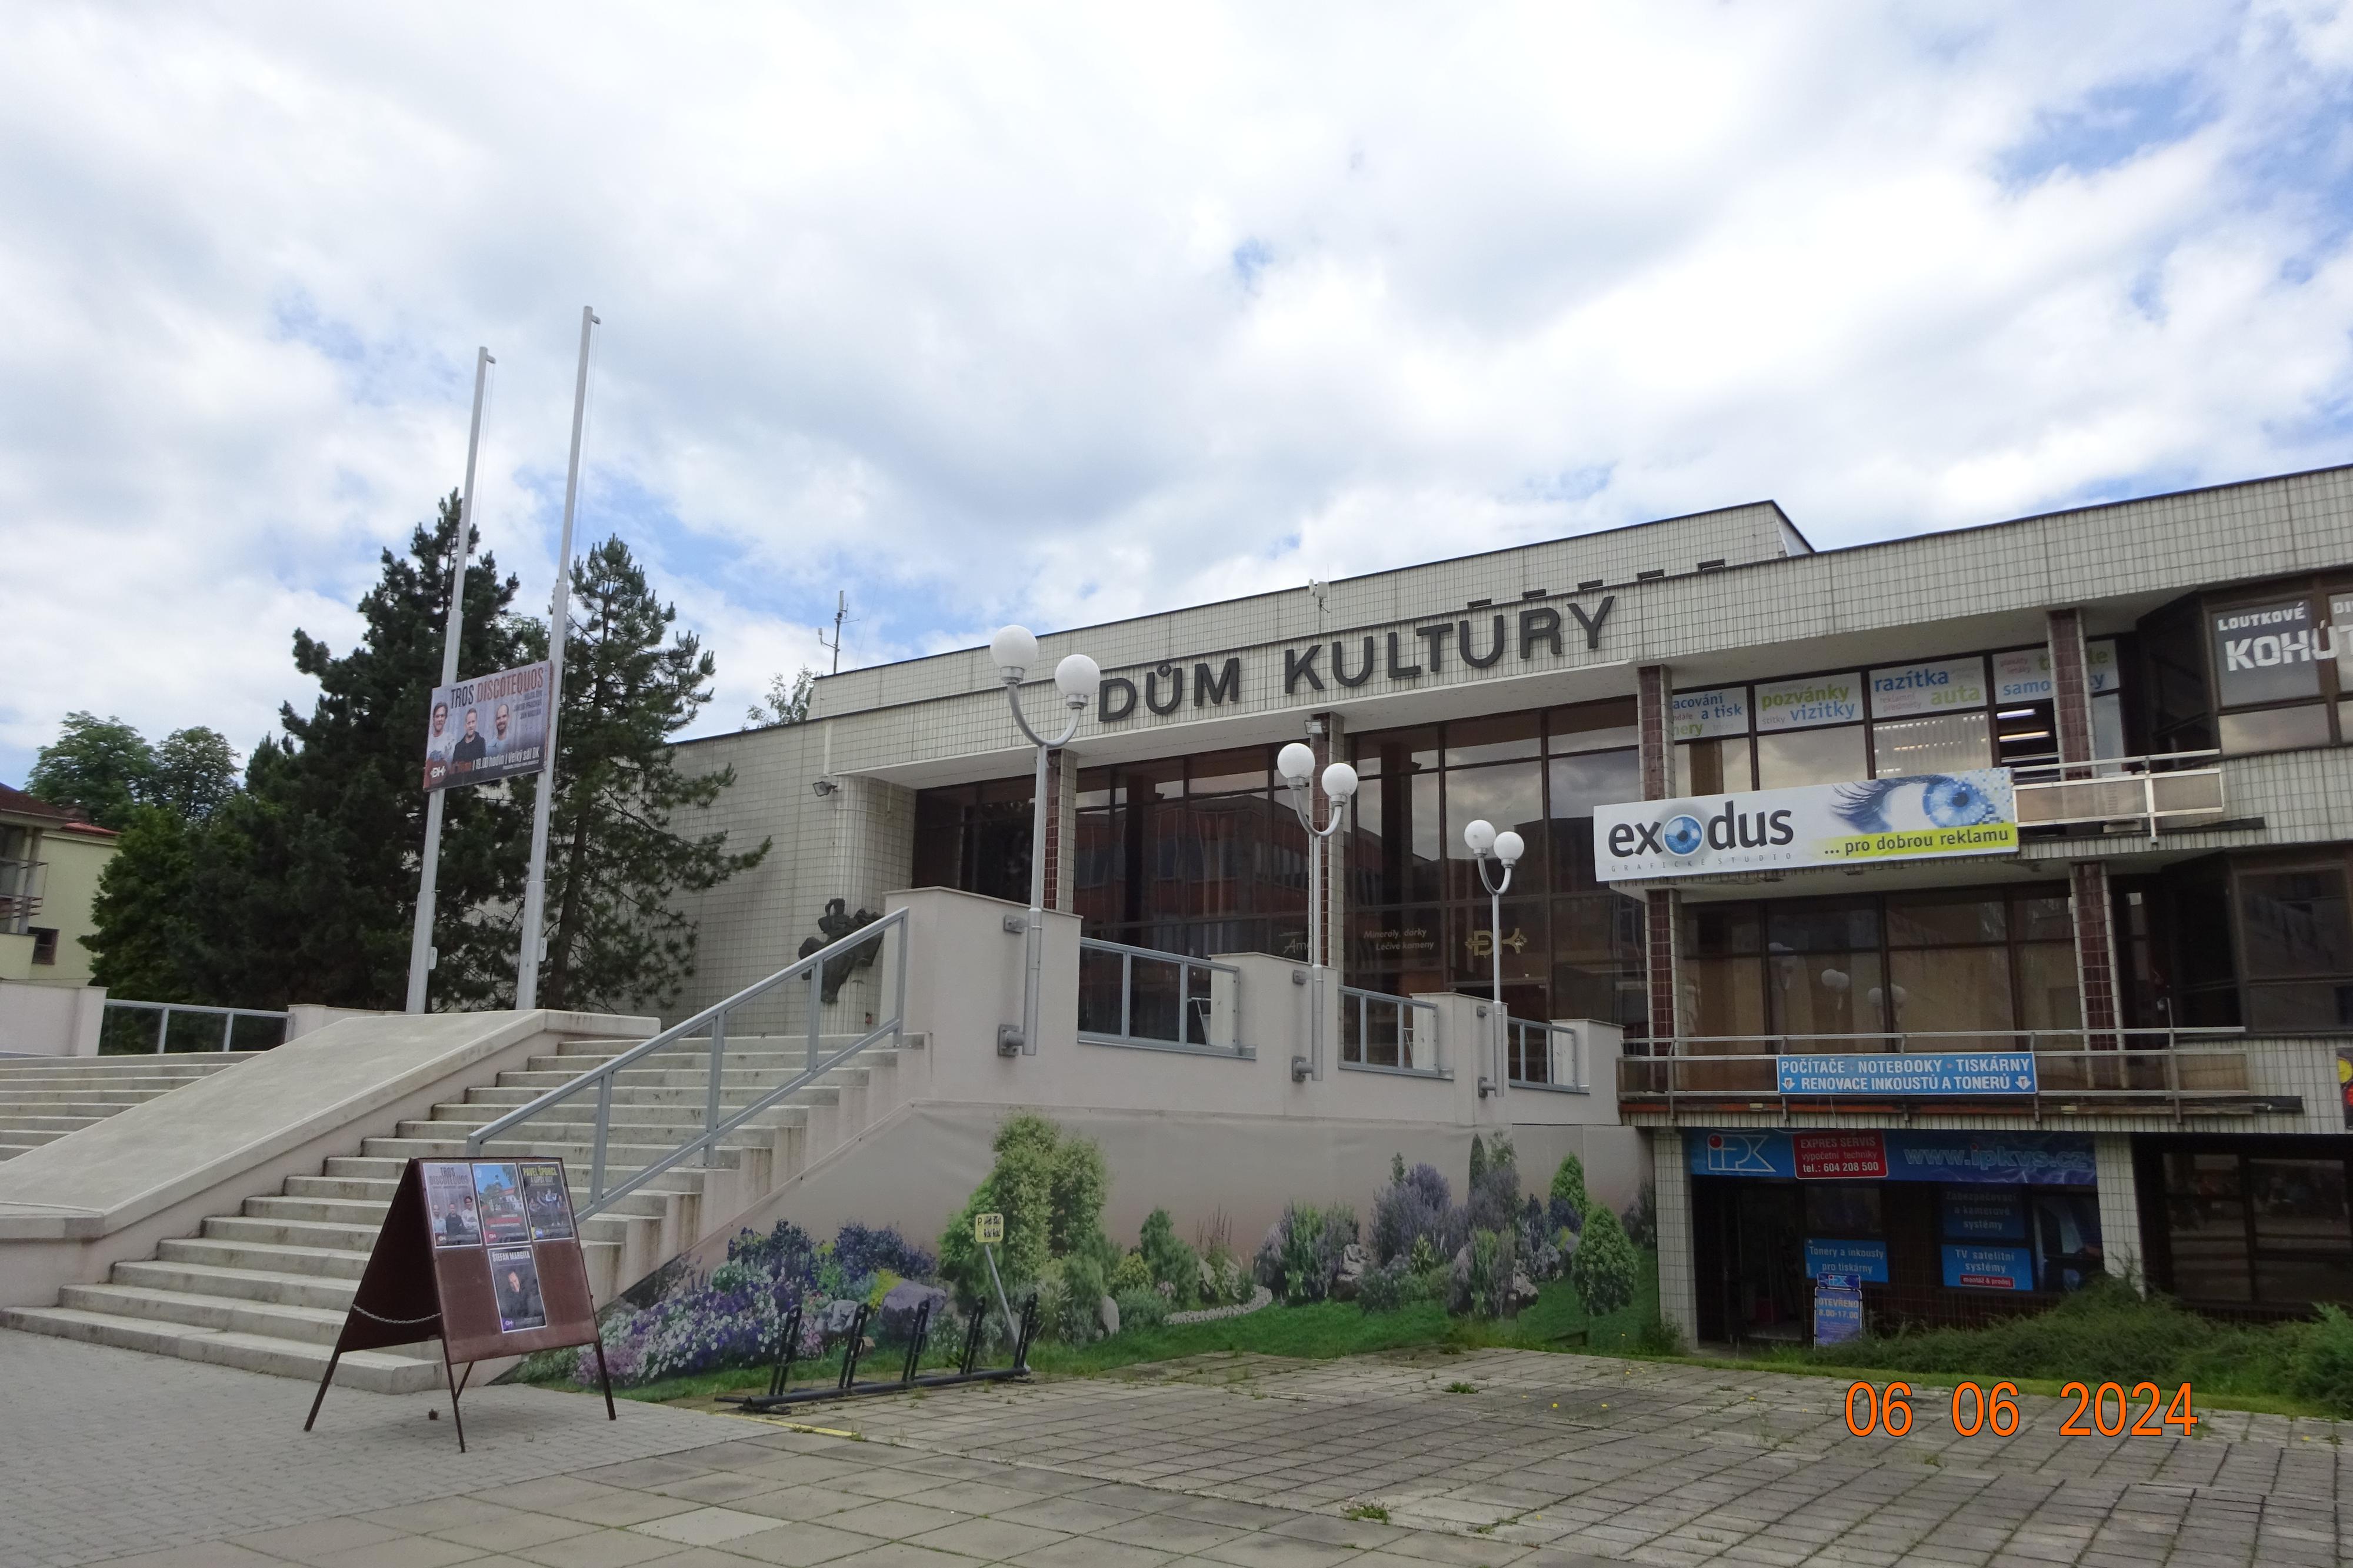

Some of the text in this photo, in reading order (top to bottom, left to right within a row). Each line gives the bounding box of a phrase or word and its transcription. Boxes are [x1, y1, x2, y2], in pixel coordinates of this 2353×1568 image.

[2218, 602, 2306, 631] LOUTKOVÉ
[1098, 596, 1615, 722] DŮM KULTURY
[451, 667, 544, 709] TROS DISCOTEQUOS
[1874, 668, 1949, 692] razítka
[1672, 692, 1723, 709] acování
[1761, 683, 1849, 712] pozvánky
[1931, 685, 1981, 705] auta
[1701, 703, 1743, 719] a tisk
[1789, 700, 1855, 721] vizitky
[1845, 840, 1870, 856] pro
[1877, 836, 1933, 850] dobrou
[1940, 829, 2009, 846] reklamu
[1718, 853, 1791, 865] STUDIO
[1402, 940, 1434, 950] kameny
[1781, 1056, 2030, 1073] POČÍTAČE NOTEBOOKY TISKÁRNY
[1801, 1073, 2010, 1090] RENOVACE INKOUSTŮ A TONERŮ
[1801, 1136, 1876, 1149] EXPRES SERVIS
[1802, 1150, 1878, 1161] výpočetní techniky
[1904, 1143, 2088, 1170] www.ipkvs.cz
[1803, 1162, 1878, 1173] tel.: 604 208 500
[977, 1217, 983, 1226] P
[1962, 1219, 2003, 1231] systémy
[1809, 1246, 1837, 1257] Tonery
[1848, 1249, 1884, 1260] inkousty
[1955, 1249, 2015, 1261] TV satelitní
[1822, 1263, 1873, 1274] pro tiskárny
[1965, 1262, 2006, 1274] systémy
